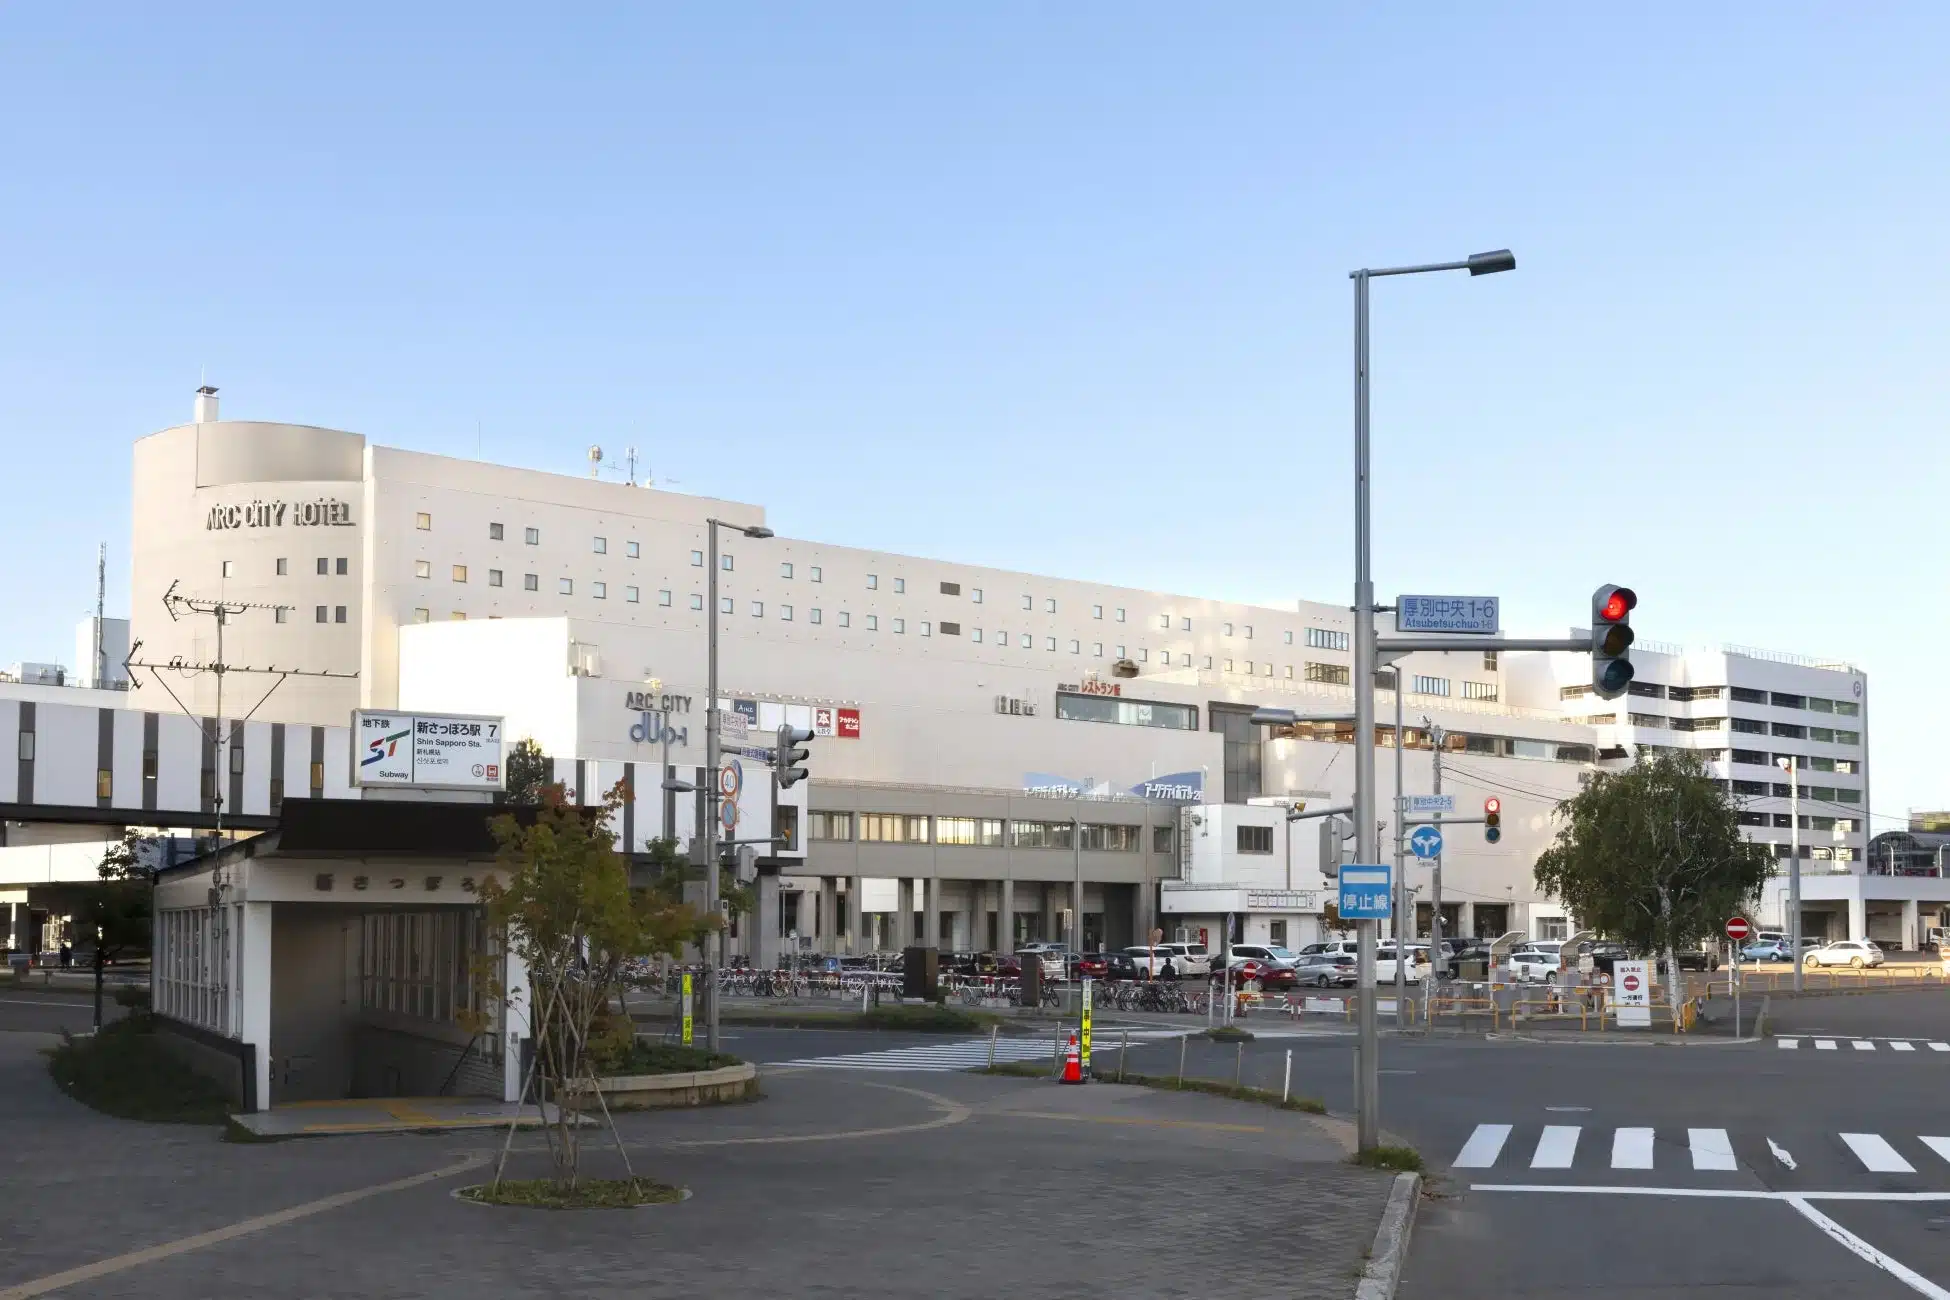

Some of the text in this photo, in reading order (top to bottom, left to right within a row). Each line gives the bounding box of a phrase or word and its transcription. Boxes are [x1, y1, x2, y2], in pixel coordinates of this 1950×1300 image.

[207, 498, 356, 530] ARC CITY HOTEL
[1404, 598, 1494, 618] 厚別中央1-6
[1405, 618, 1493, 629] Atsubetsu-chuo 1-6
[625, 691, 692, 713] ARC CITY
[362, 718, 391, 729] 地下鉄
[817, 712, 830, 726] 本
[417, 721, 481, 736] 新さっぽろ駅
[488, 724, 498, 738] 7
[417, 738, 482, 748] Shin Sapporo Sta.
[379, 771, 409, 780] Subway
[725, 774, 735, 789] 40
[1343, 893, 1389, 911] 停止線
